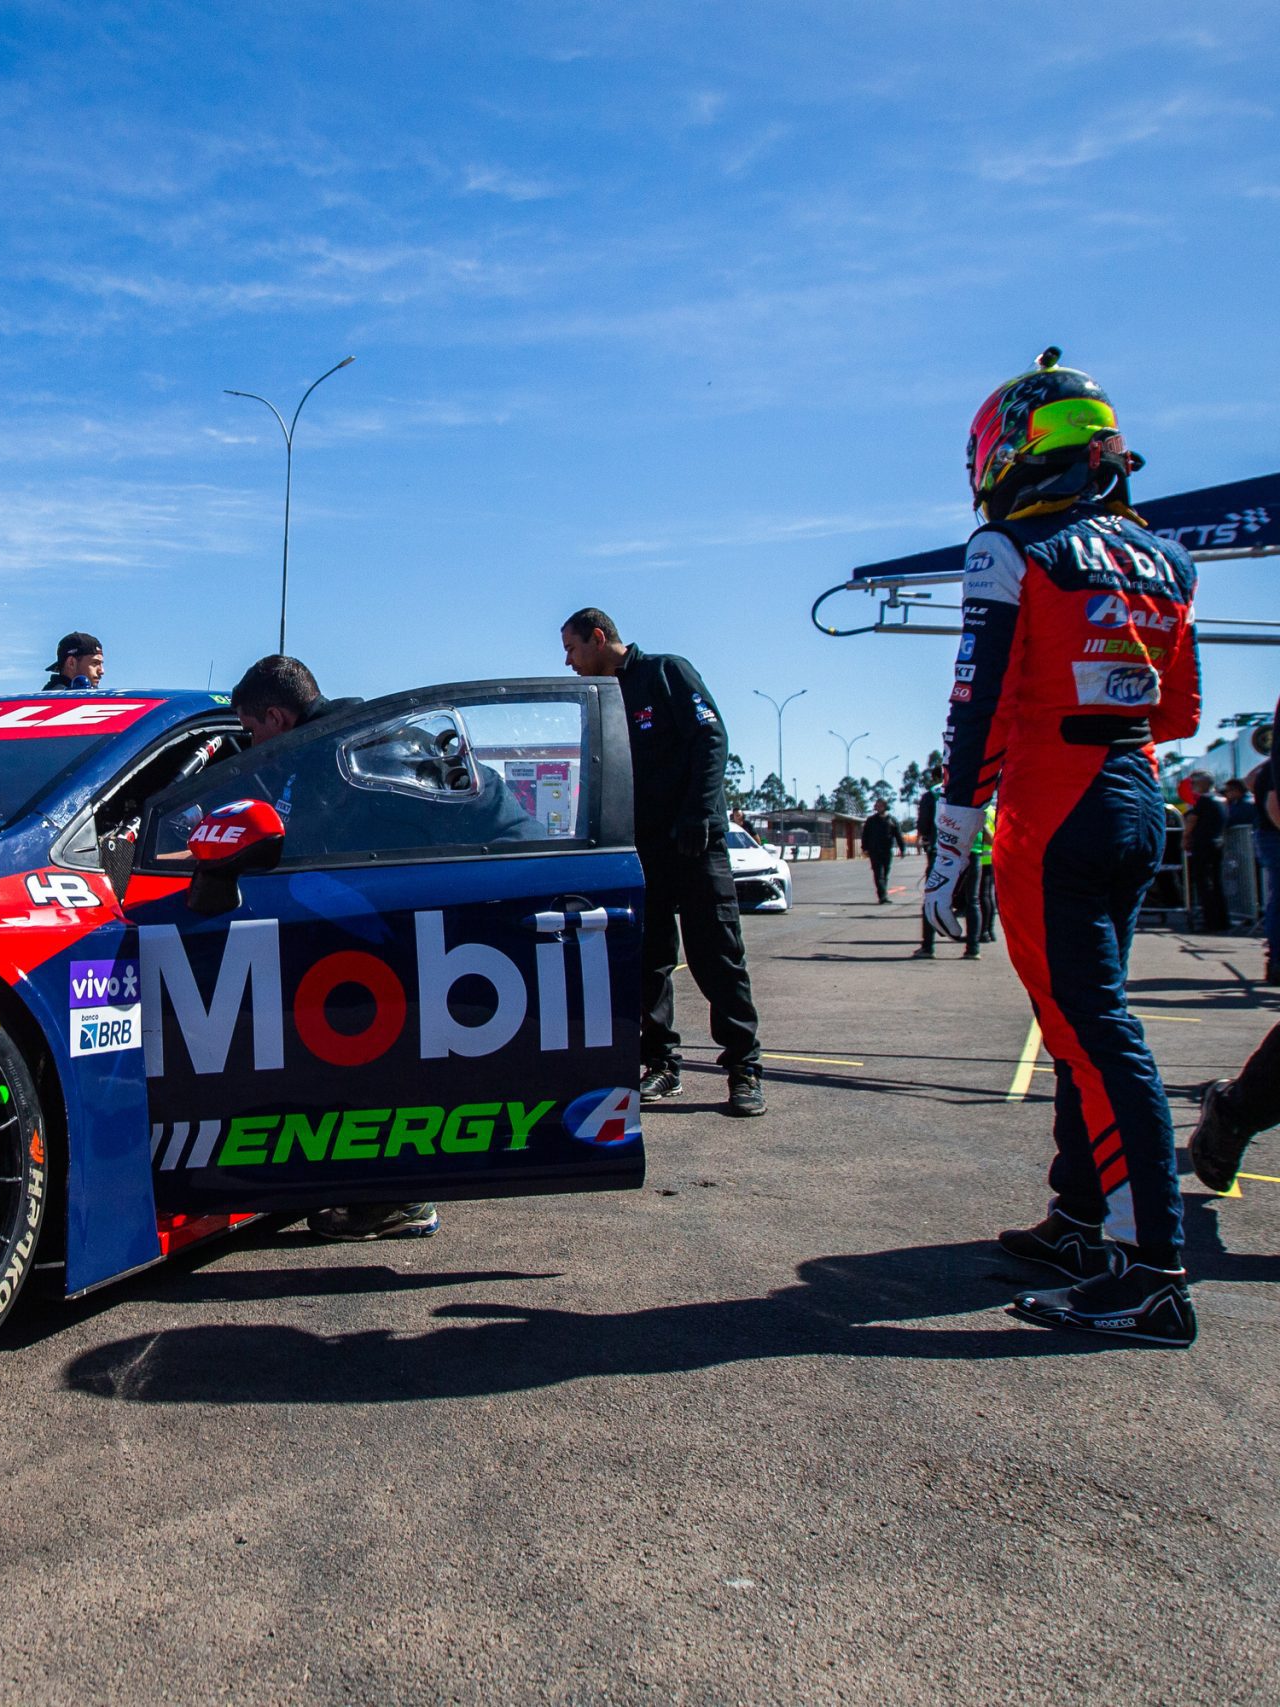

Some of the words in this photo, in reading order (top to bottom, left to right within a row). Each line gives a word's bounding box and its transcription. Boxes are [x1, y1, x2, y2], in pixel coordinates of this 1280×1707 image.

[190, 825, 247, 844] ALE
[72, 968, 120, 999] vivo
[138, 909, 613, 1077] Mobil
[81, 1014, 99, 1022] banco
[98, 1019, 132, 1048] BRB
[217, 1100, 557, 1167] ENERGY
